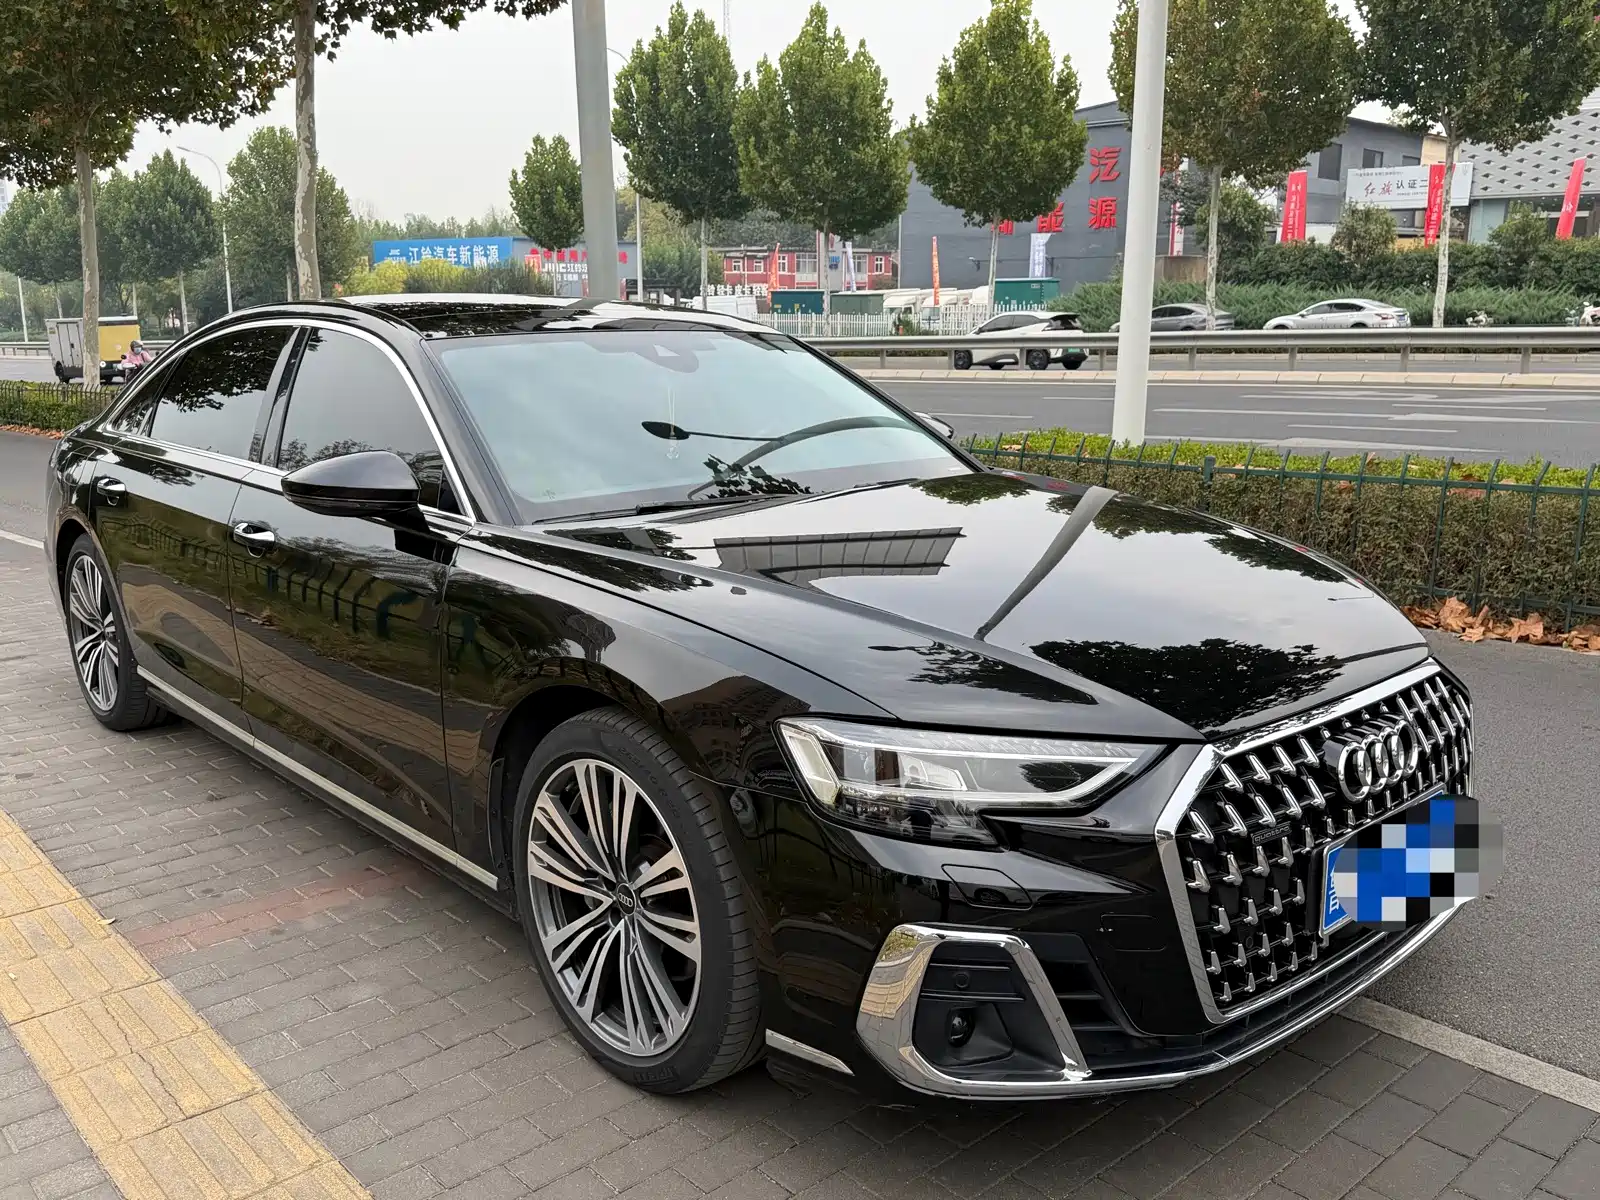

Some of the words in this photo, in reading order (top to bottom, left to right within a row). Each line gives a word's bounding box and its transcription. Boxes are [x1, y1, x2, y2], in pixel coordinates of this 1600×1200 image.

[408, 244, 500, 267] 江铃汽车新能源
[1254, 825, 1290, 843] quattro
